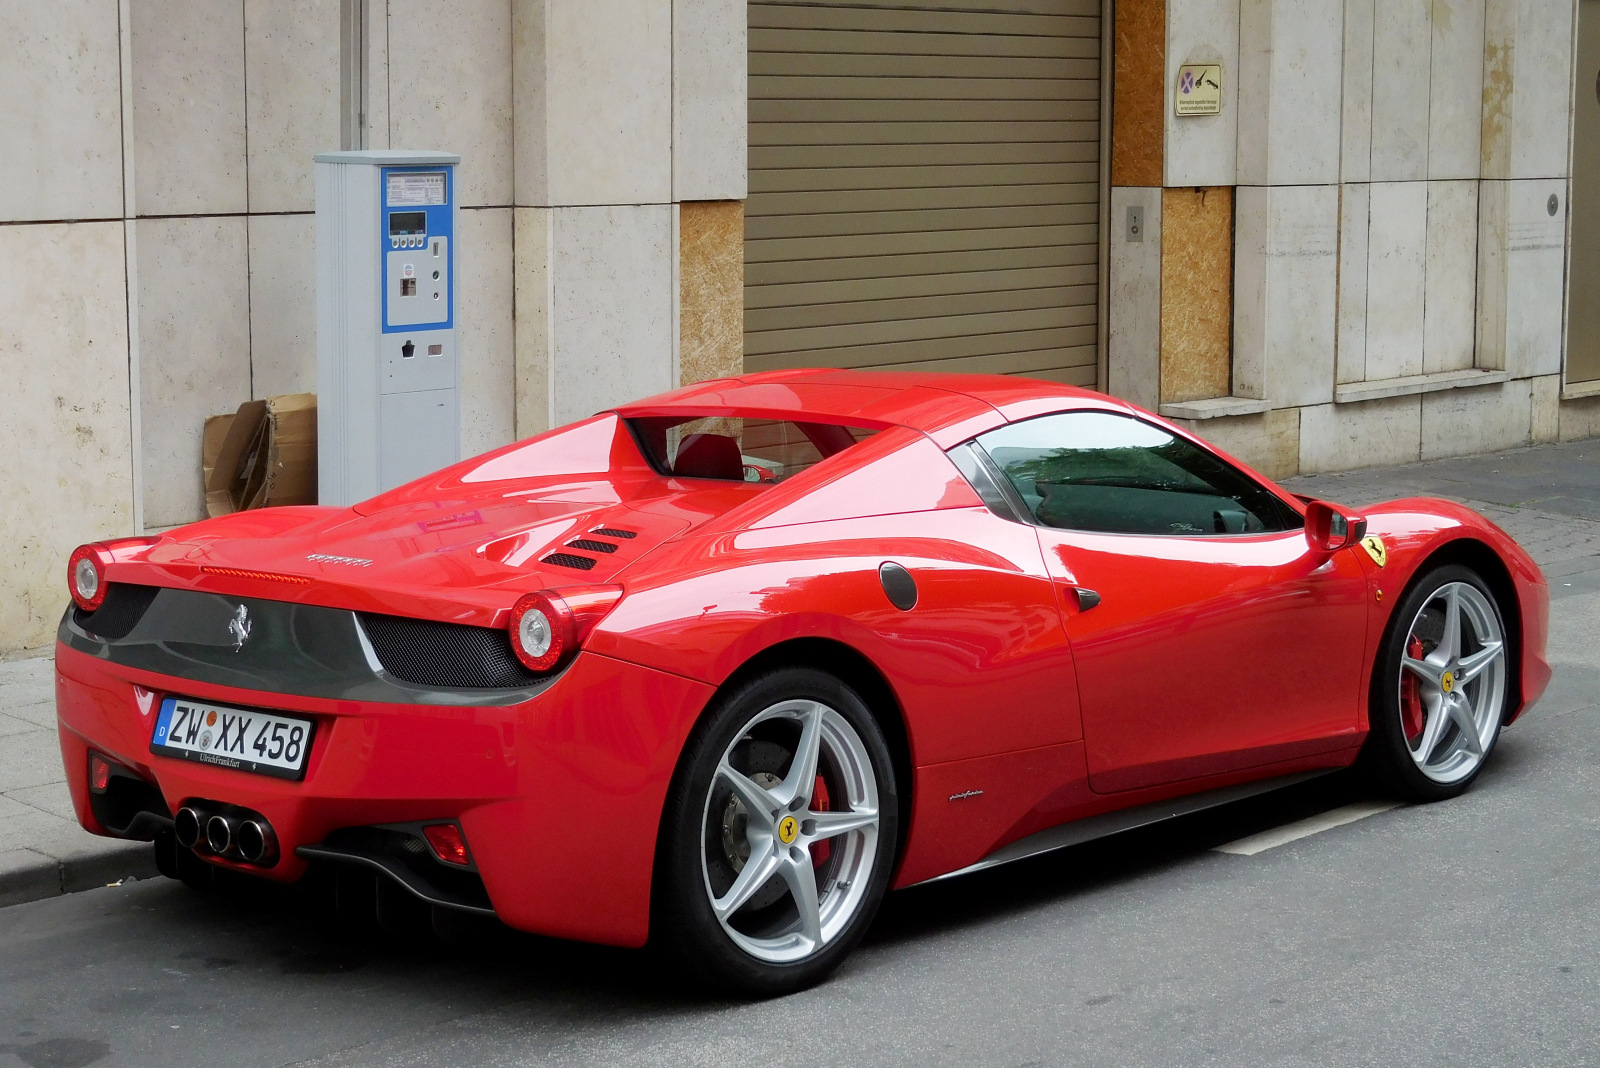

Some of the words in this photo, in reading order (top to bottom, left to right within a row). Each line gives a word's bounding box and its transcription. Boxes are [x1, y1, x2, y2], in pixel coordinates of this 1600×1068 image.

[159, 726, 166, 737] D
[168, 706, 205, 745] ZW
[214, 713, 252, 754] XX
[253, 720, 304, 763] 458
